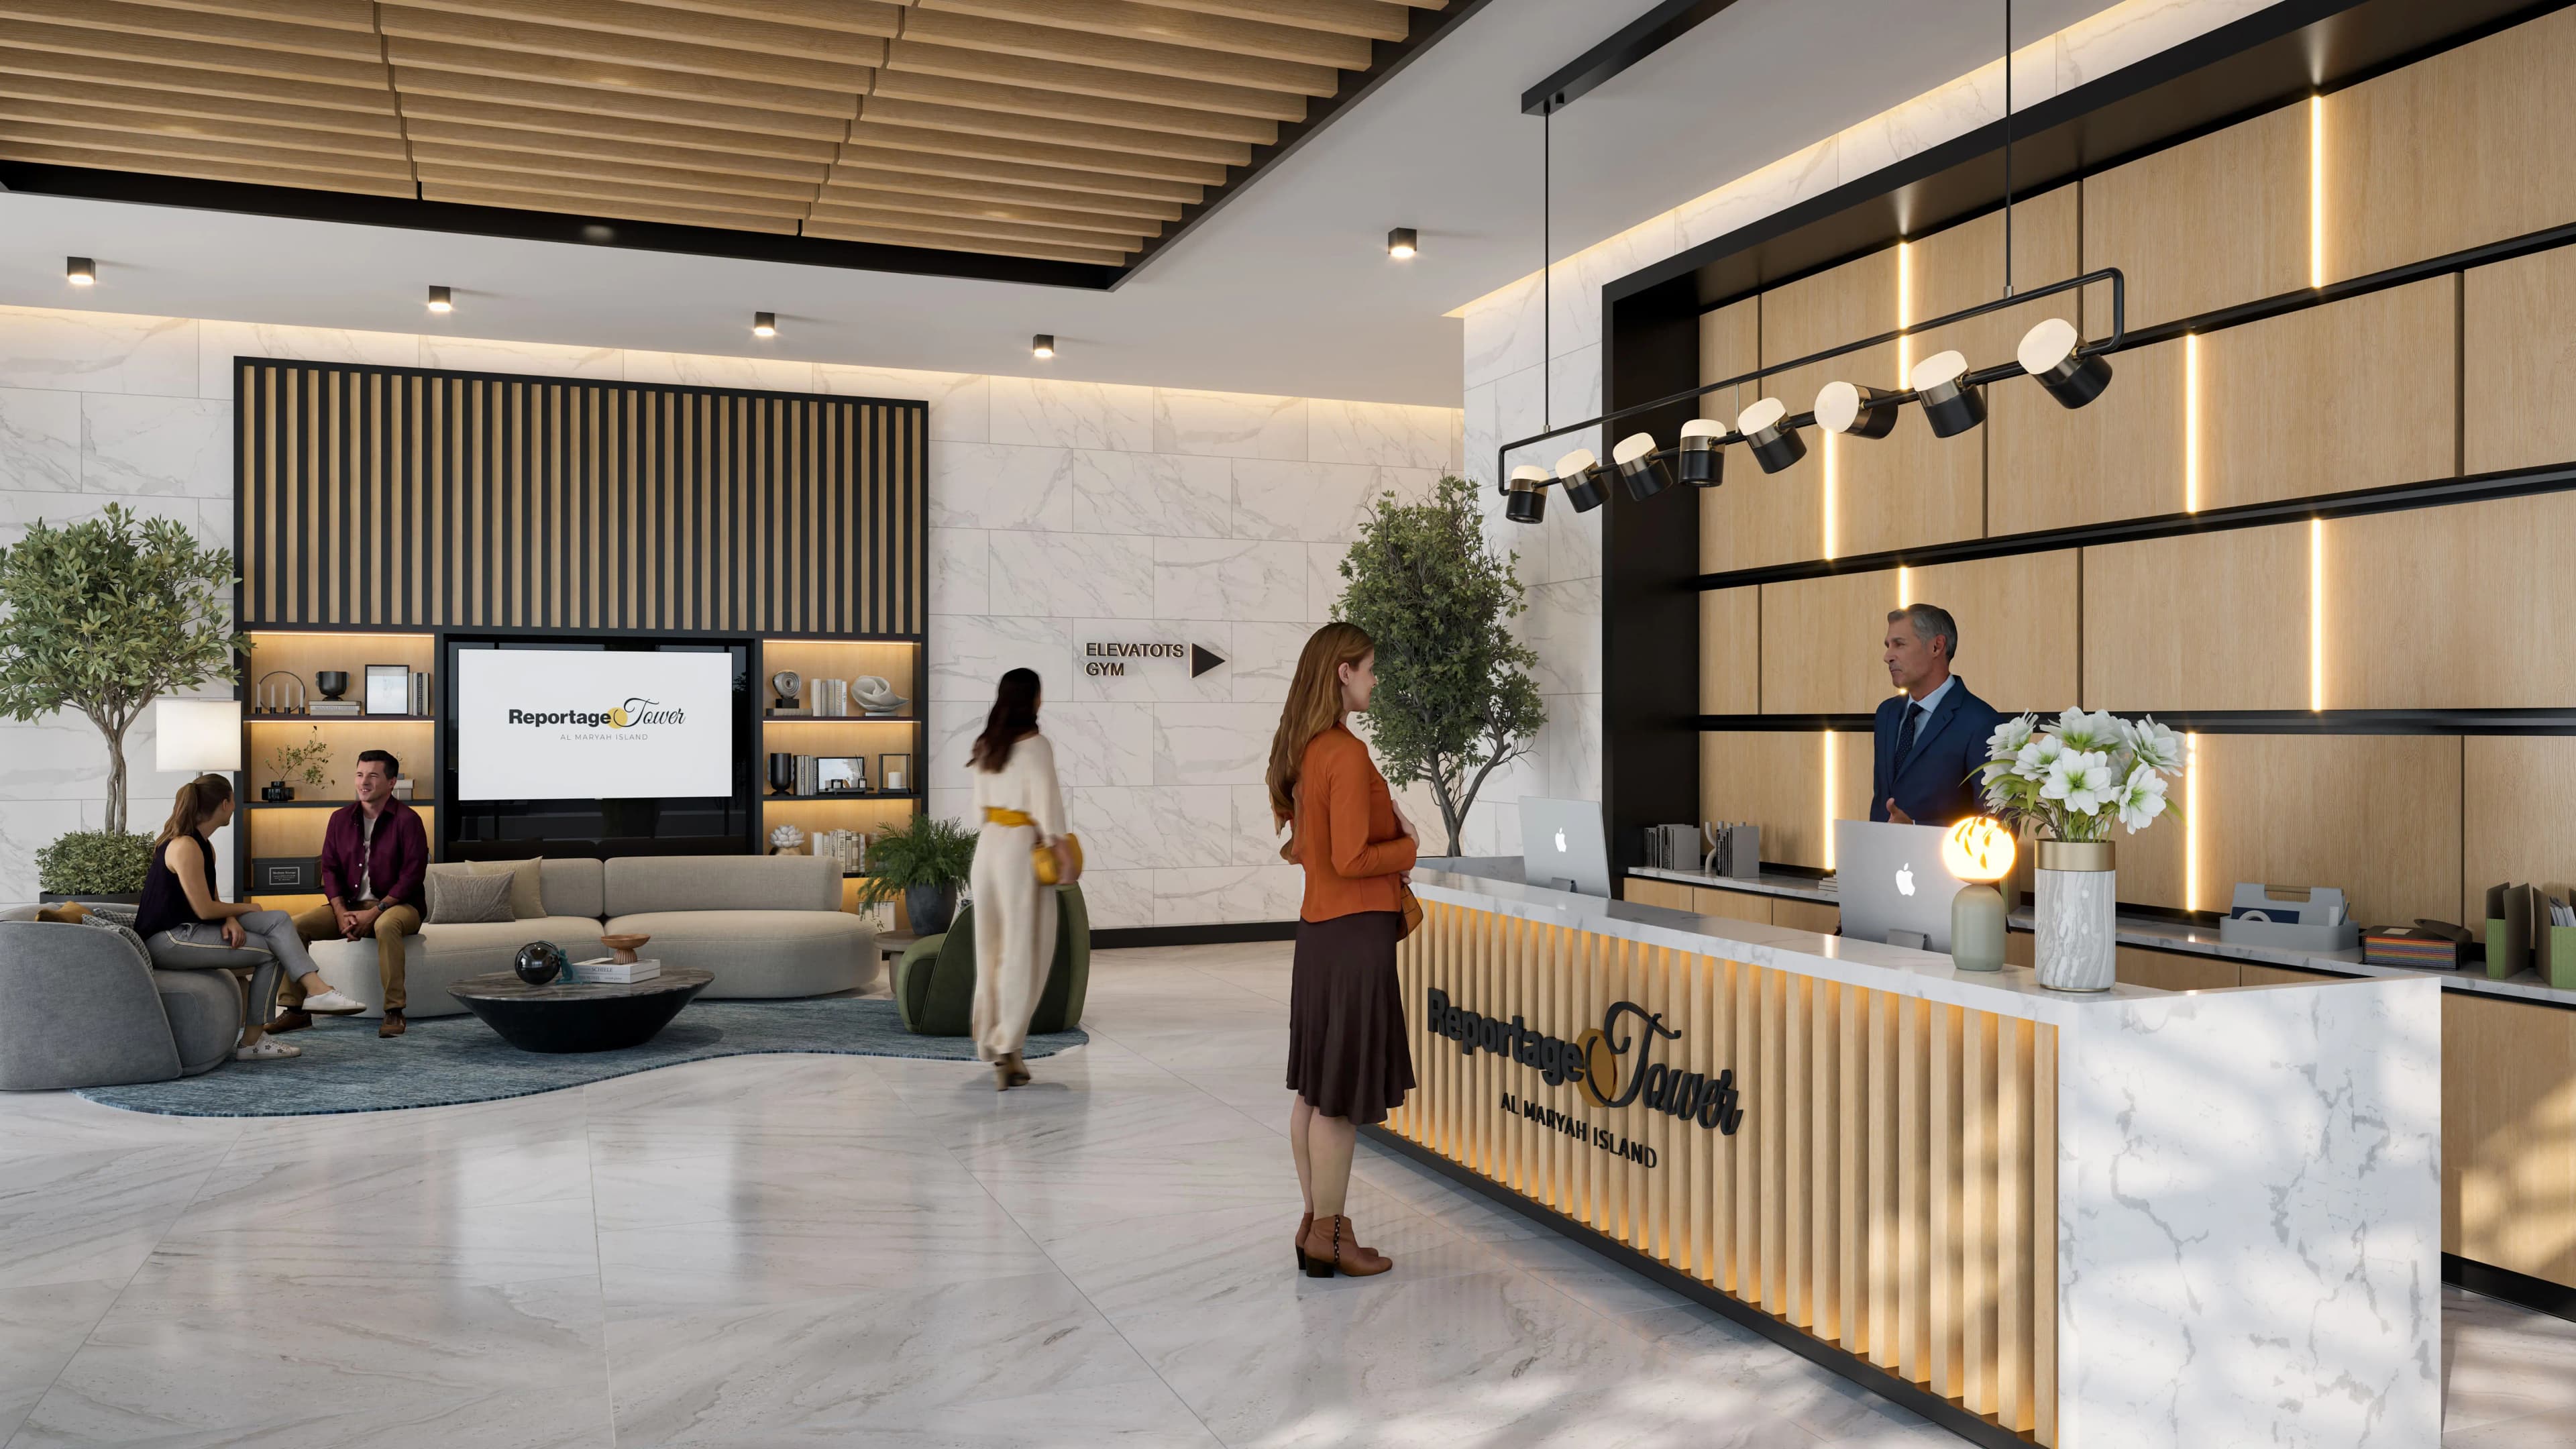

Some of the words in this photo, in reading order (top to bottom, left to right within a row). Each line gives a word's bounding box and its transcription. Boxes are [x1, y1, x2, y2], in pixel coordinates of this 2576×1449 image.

[1085, 642, 1184, 657] ELEVATOTS
[1085, 661, 1124, 676] GYM
[508, 708, 611, 728] Reportage
[613, 697, 686, 728] Tower
[1427, 987, 1585, 1086] Reportage
[1585, 1001, 1744, 1136] Tower
[1500, 1092, 1519, 1115] AL
[1523, 1099, 1587, 1142] MARYAH
[1593, 1126, 1657, 1169] ISLAND
